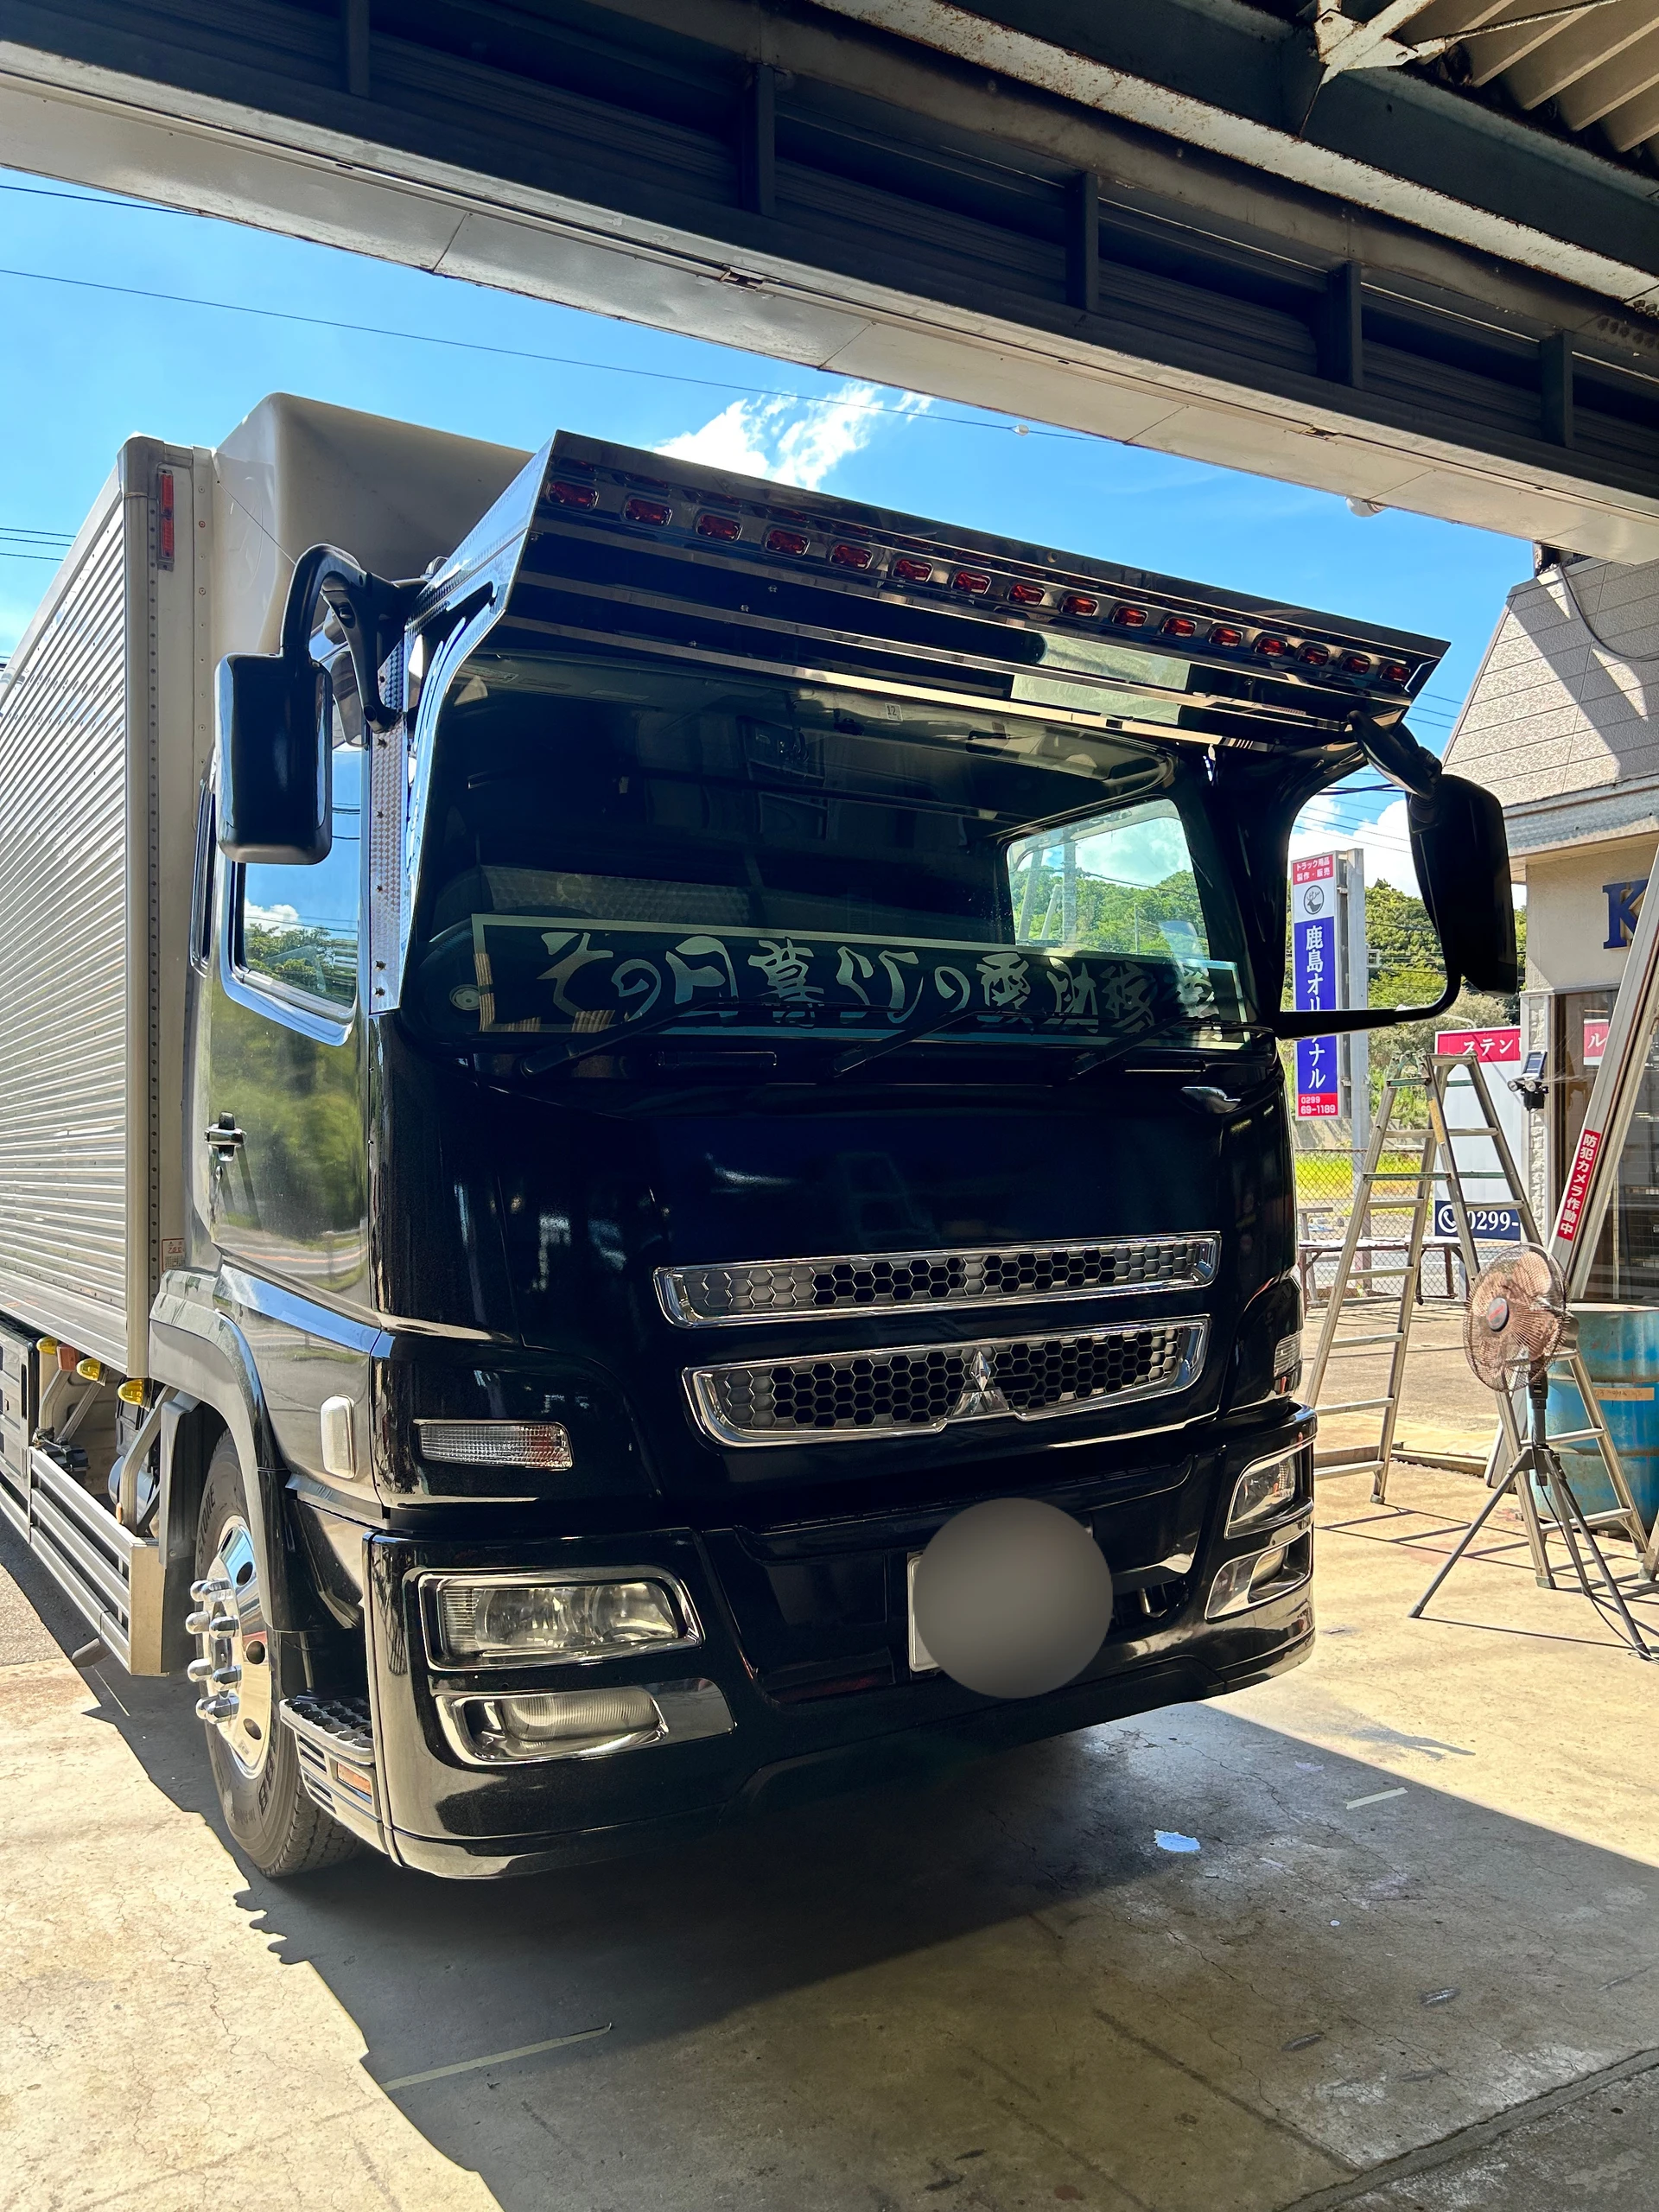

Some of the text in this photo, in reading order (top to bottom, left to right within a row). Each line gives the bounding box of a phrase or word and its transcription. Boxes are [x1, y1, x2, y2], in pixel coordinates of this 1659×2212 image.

[1296, 856, 1331, 871] トラック用品
[1296, 867, 1331, 882] 製作・販売
[1462, 1038, 1521, 1057] ステン
[1300, 1096, 1321, 1104] 0299
[1300, 1104, 1336, 1116] 69-1189
[1560, 1133, 1598, 1236] 防犯カメラ作動中
